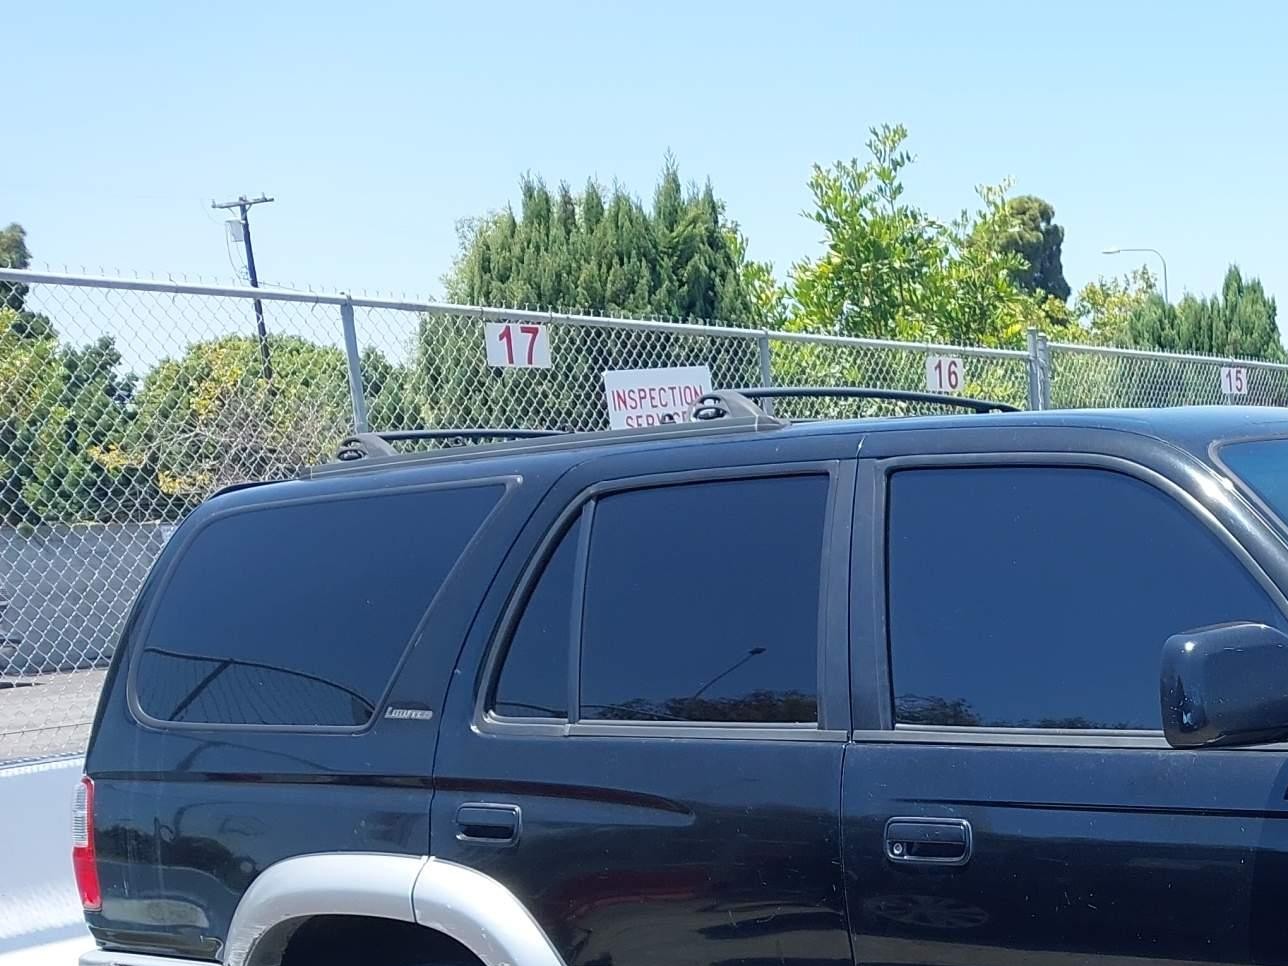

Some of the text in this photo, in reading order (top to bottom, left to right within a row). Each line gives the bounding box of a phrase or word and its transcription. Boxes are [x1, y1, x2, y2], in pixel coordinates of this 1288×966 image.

[499, 325, 539, 365] 17
[934, 359, 958, 390] 16
[1226, 369, 1243, 393] 15
[611, 384, 704, 411] INSPECTION
